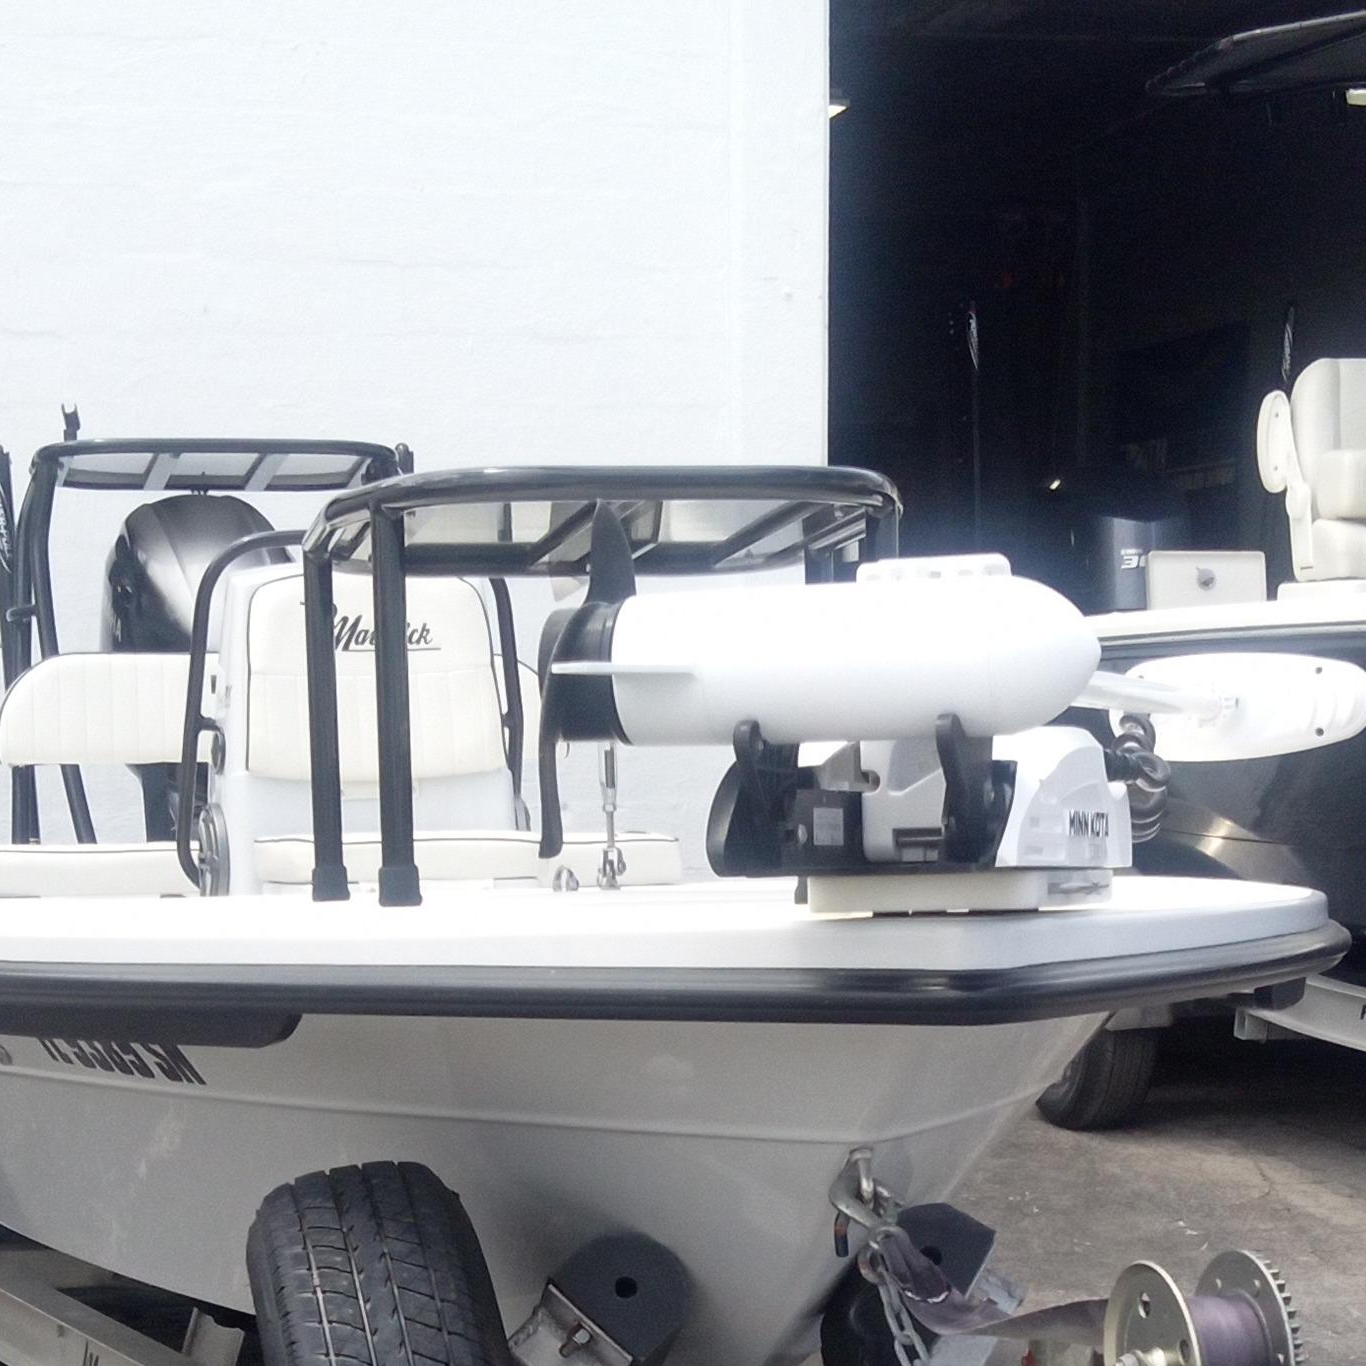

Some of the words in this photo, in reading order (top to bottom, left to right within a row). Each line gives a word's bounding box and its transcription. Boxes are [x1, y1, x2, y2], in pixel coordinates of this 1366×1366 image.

[331, 604, 433, 650] Maick
[1068, 810, 1089, 838] MINN
[1089, 812, 1109, 838] KOTA
